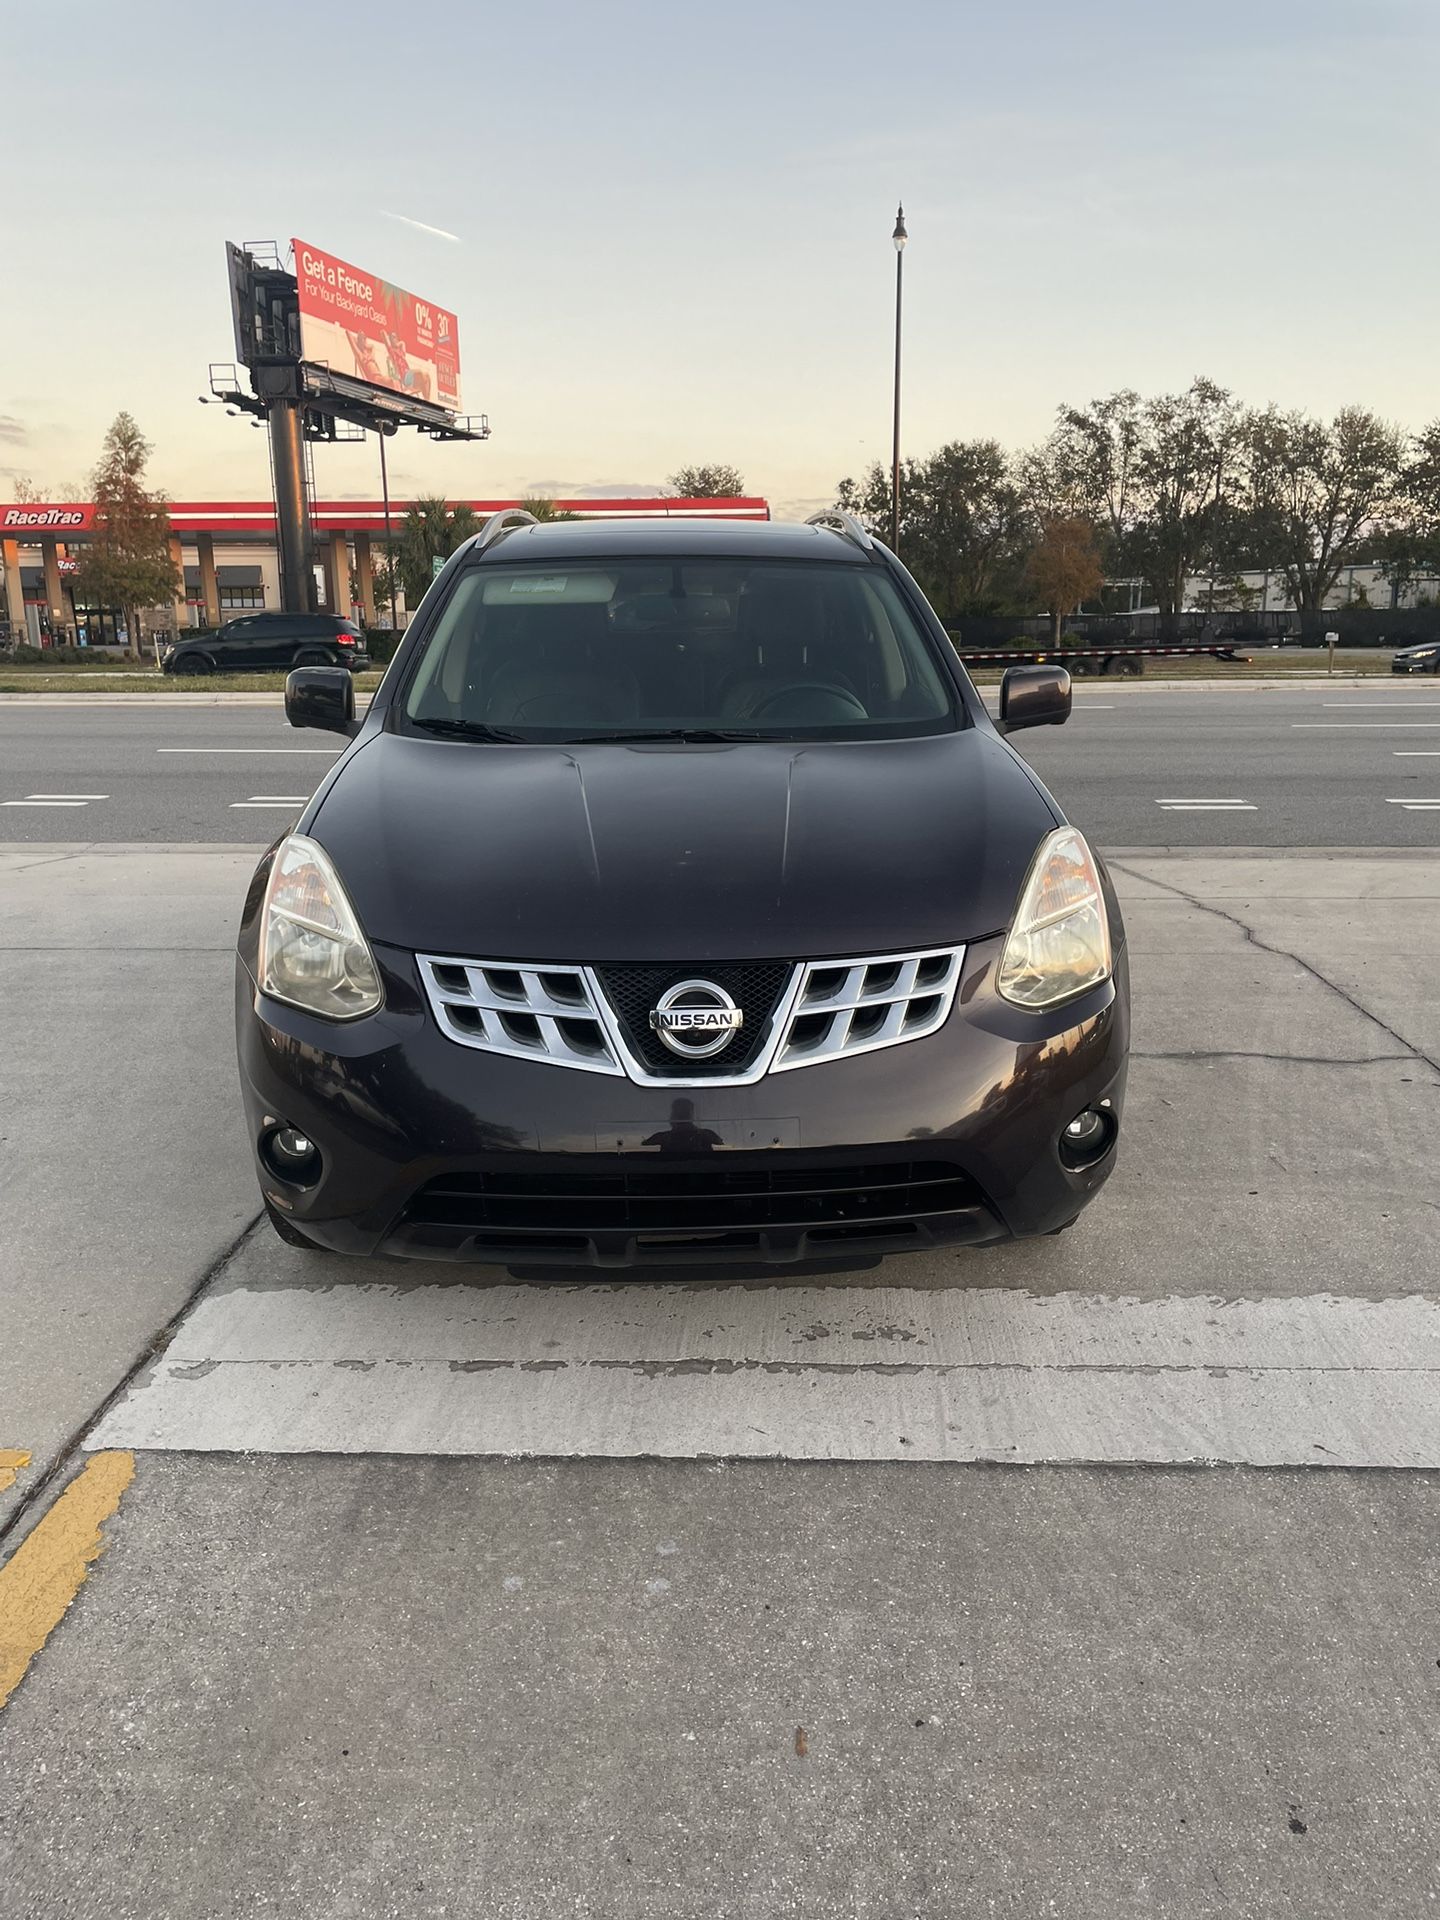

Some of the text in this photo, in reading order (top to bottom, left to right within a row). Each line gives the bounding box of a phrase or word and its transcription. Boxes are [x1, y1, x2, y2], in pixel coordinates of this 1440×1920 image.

[302, 251, 373, 302] Get a Fence
[304, 278, 387, 326] For Your Backyard Oasis
[415, 302, 433, 330] 0%
[4, 509, 83, 525] RaceTrac
[660, 1013, 733, 1026] NISSAN
